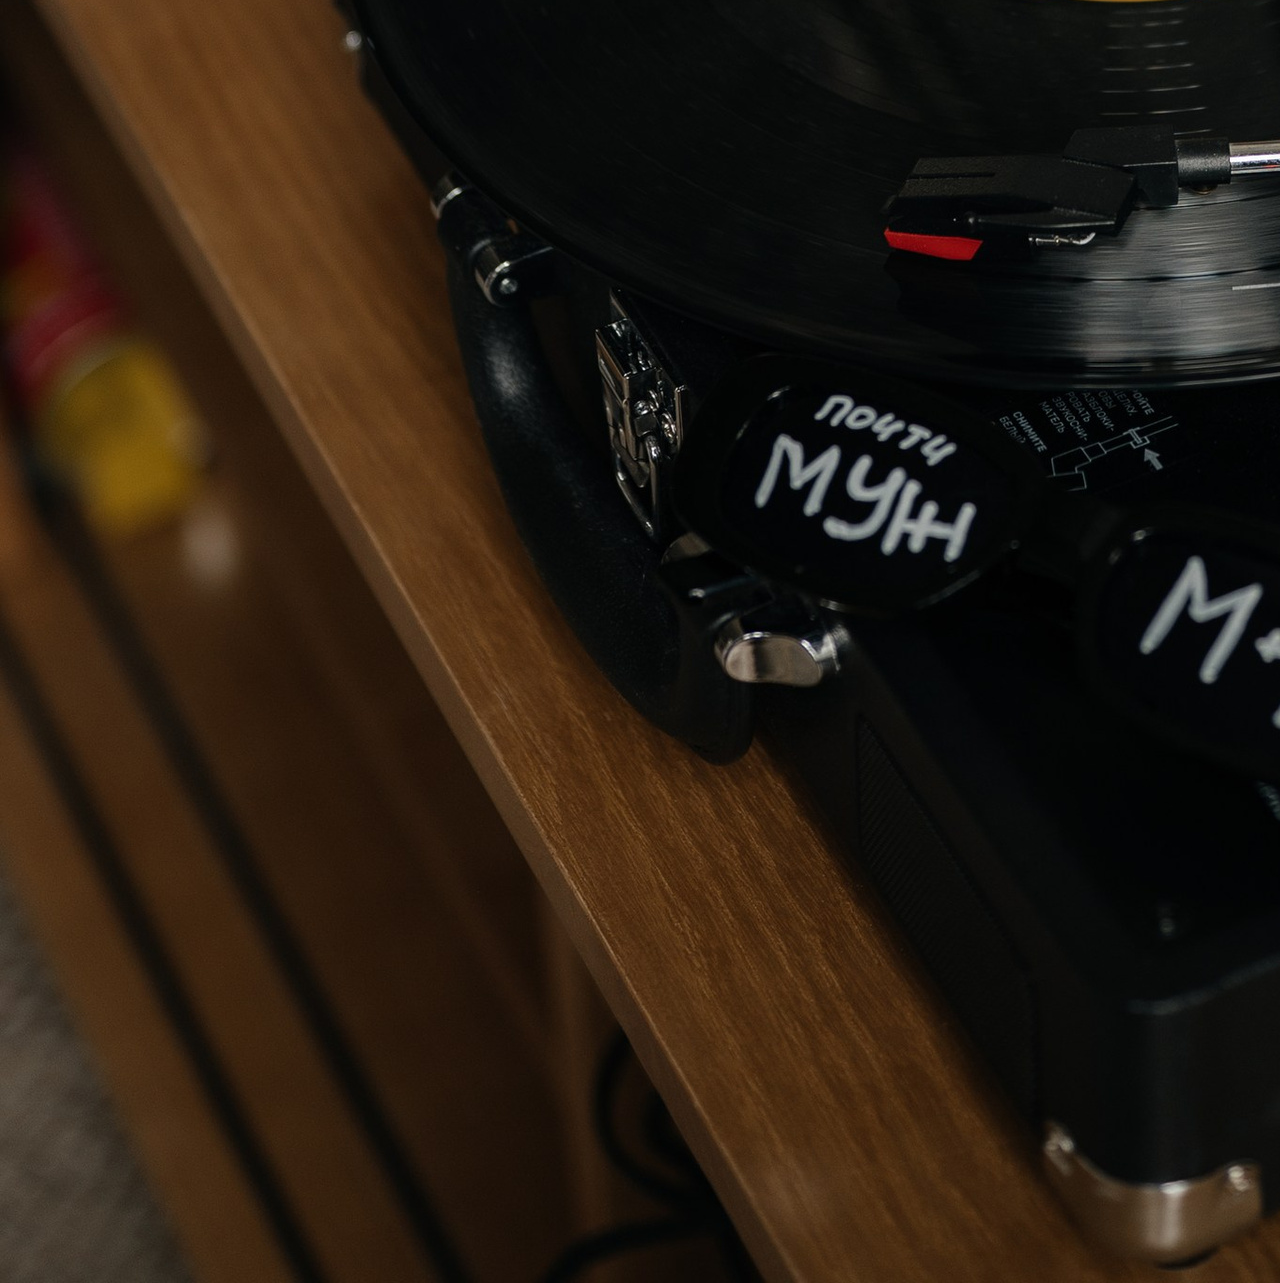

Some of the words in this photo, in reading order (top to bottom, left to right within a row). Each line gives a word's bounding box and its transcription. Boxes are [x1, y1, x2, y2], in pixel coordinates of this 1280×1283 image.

[1039, 401, 1066, 434] МАТЕЛЬ
[1082, 391, 1114, 431] АЗБЛОКИ-
[1099, 390, 1117, 409] ОБЫ
[1133, 390, 1155, 416] ОЙТЕ
[1013, 411, 1047, 453] СНИМИТЕ
[755, 433, 977, 563] МУЖ
